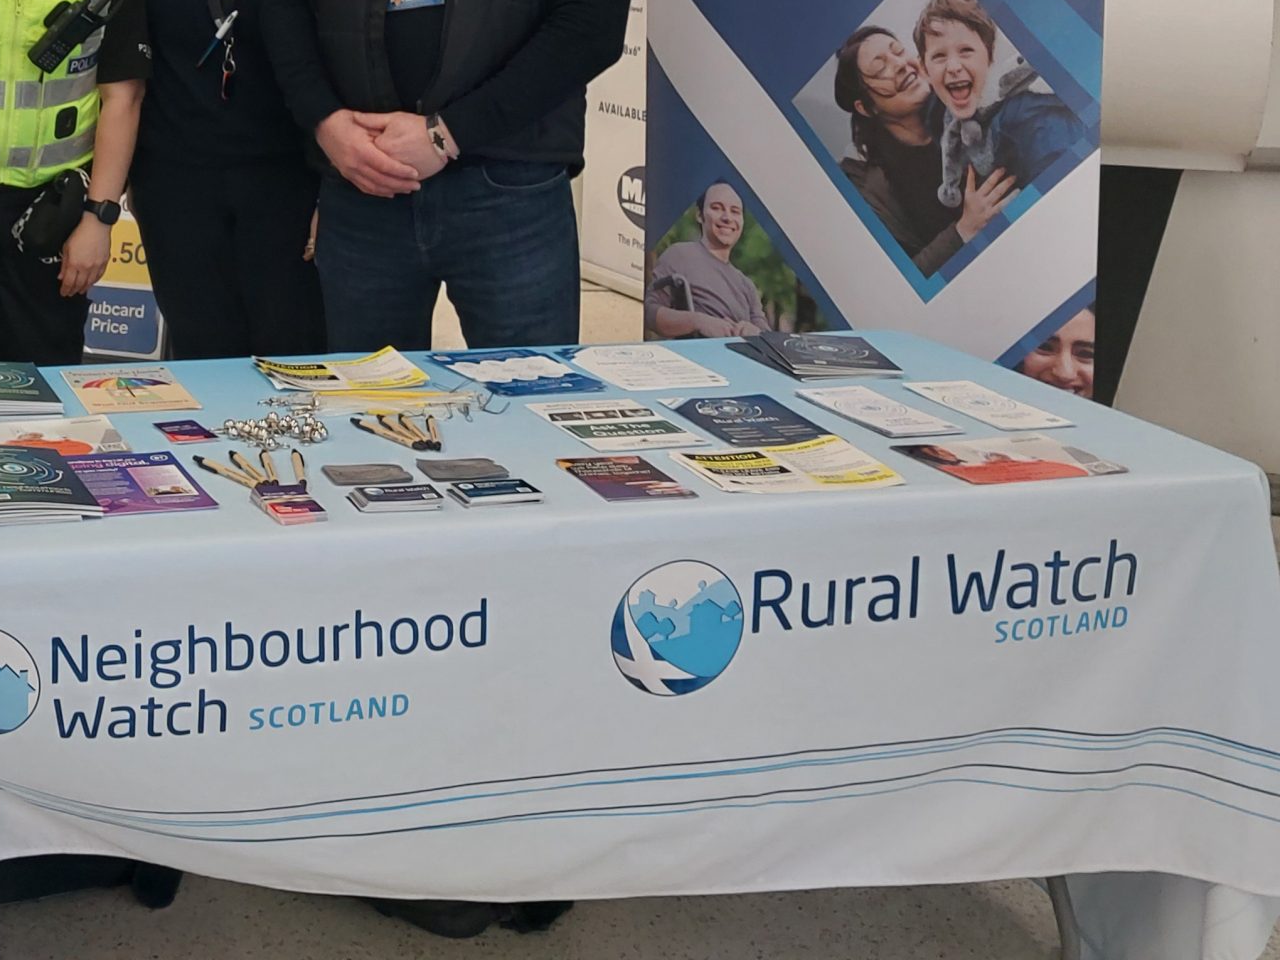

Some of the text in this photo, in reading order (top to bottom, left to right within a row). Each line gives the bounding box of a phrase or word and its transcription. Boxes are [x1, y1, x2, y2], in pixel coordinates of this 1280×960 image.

[598, 101, 647, 122] AVAILABLE
[89, 301, 145, 319] lubcard
[91, 318, 129, 334] Price
[592, 428, 667, 437] Question
[694, 452, 757, 461] ATTENTION
[750, 539, 1139, 634] Rural Watch
[995, 606, 1129, 643] SCOTLAND
[49, 598, 489, 690] Neighbourhood
[52, 688, 411, 741] Watch SCOTLAND
